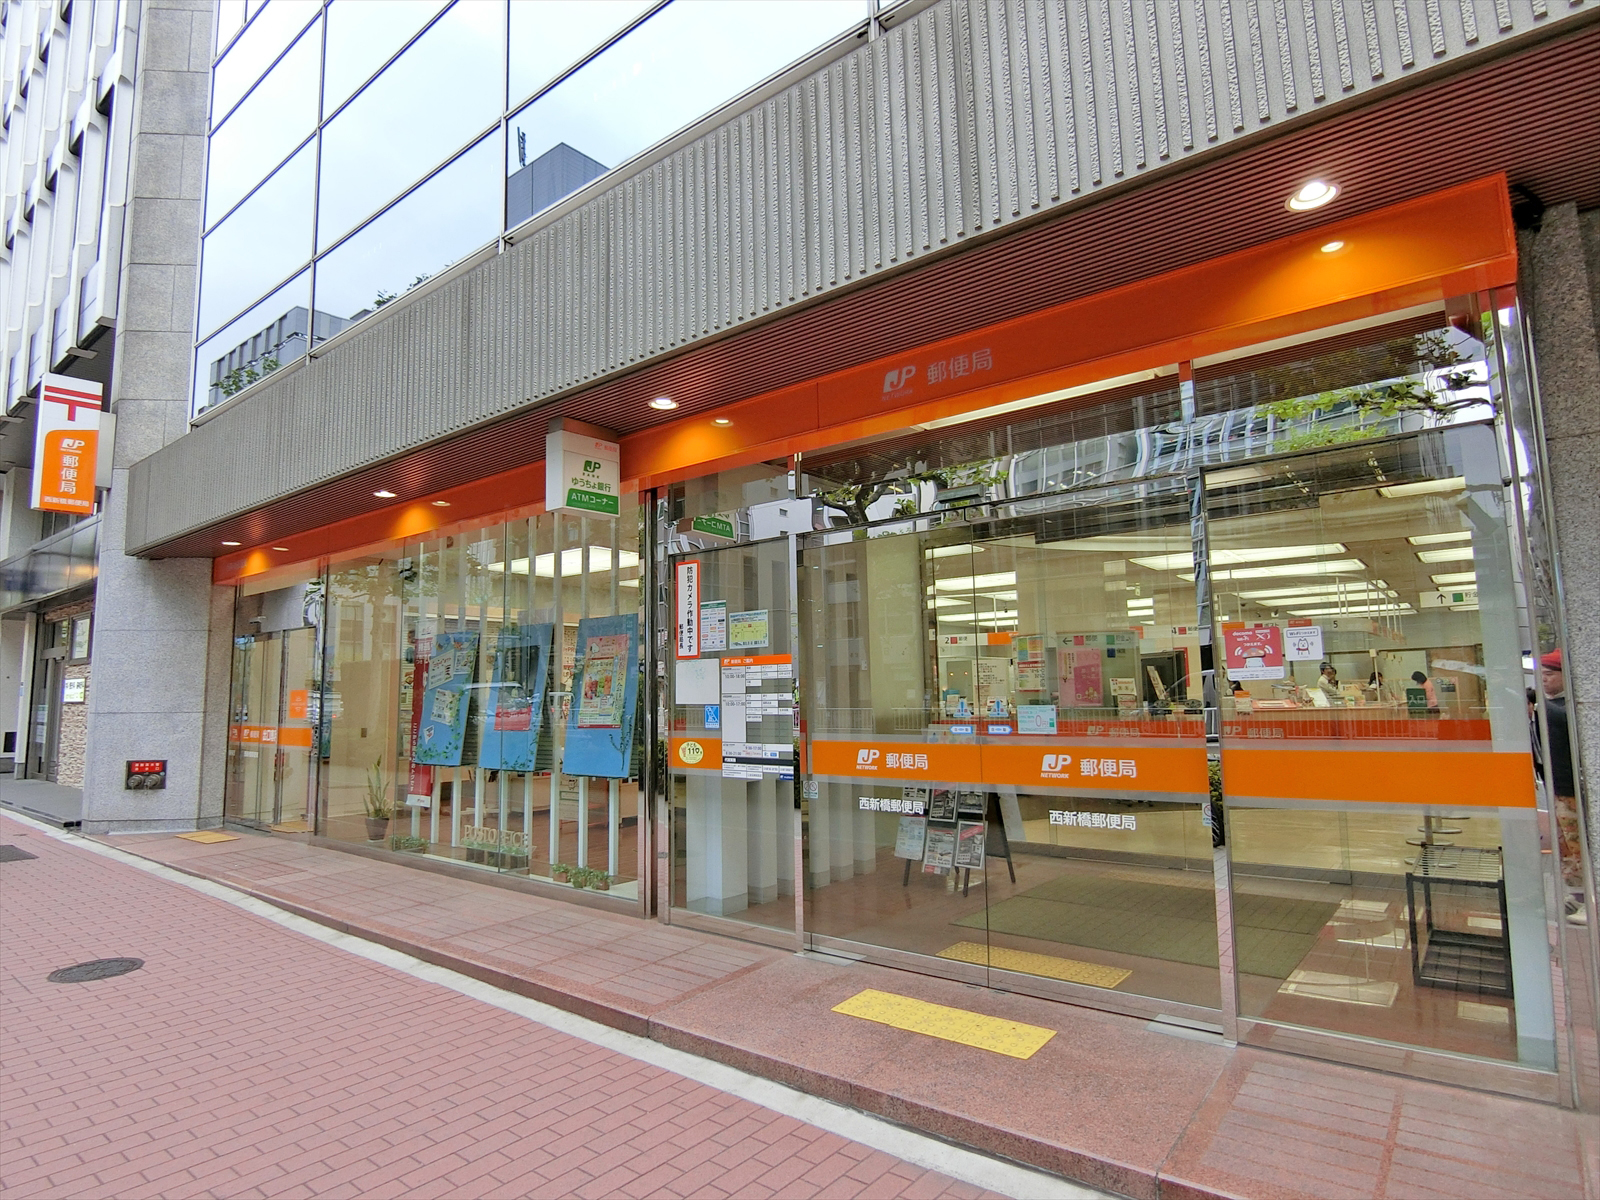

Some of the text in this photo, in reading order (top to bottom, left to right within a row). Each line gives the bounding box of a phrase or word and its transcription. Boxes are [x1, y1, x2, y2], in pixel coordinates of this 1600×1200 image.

[882, 348, 993, 394] JP 郵便局
[61, 437, 85, 449] JP
[583, 460, 602, 473] JP
[60, 454, 79, 495] 郵便局
[571, 477, 612, 493] ゆうちょ銀行
[571, 492, 614, 505] ATMコーナー
[686, 566, 694, 653] 防犯カメラ作動中です
[1333, 620, 1338, 629] 5
[945, 636, 950, 644] 2
[1408, 694, 1426, 705] 入口
[1109, 727, 1139, 738] 郵便局
[1247, 727, 1284, 738] 郵便局
[857, 749, 928, 770] JP 郵便局
[1041, 754, 1137, 778] JP 郵便局
[859, 797, 925, 815] 西新橋郵便局
[1048, 810, 1136, 831] 西新橋郵便局
